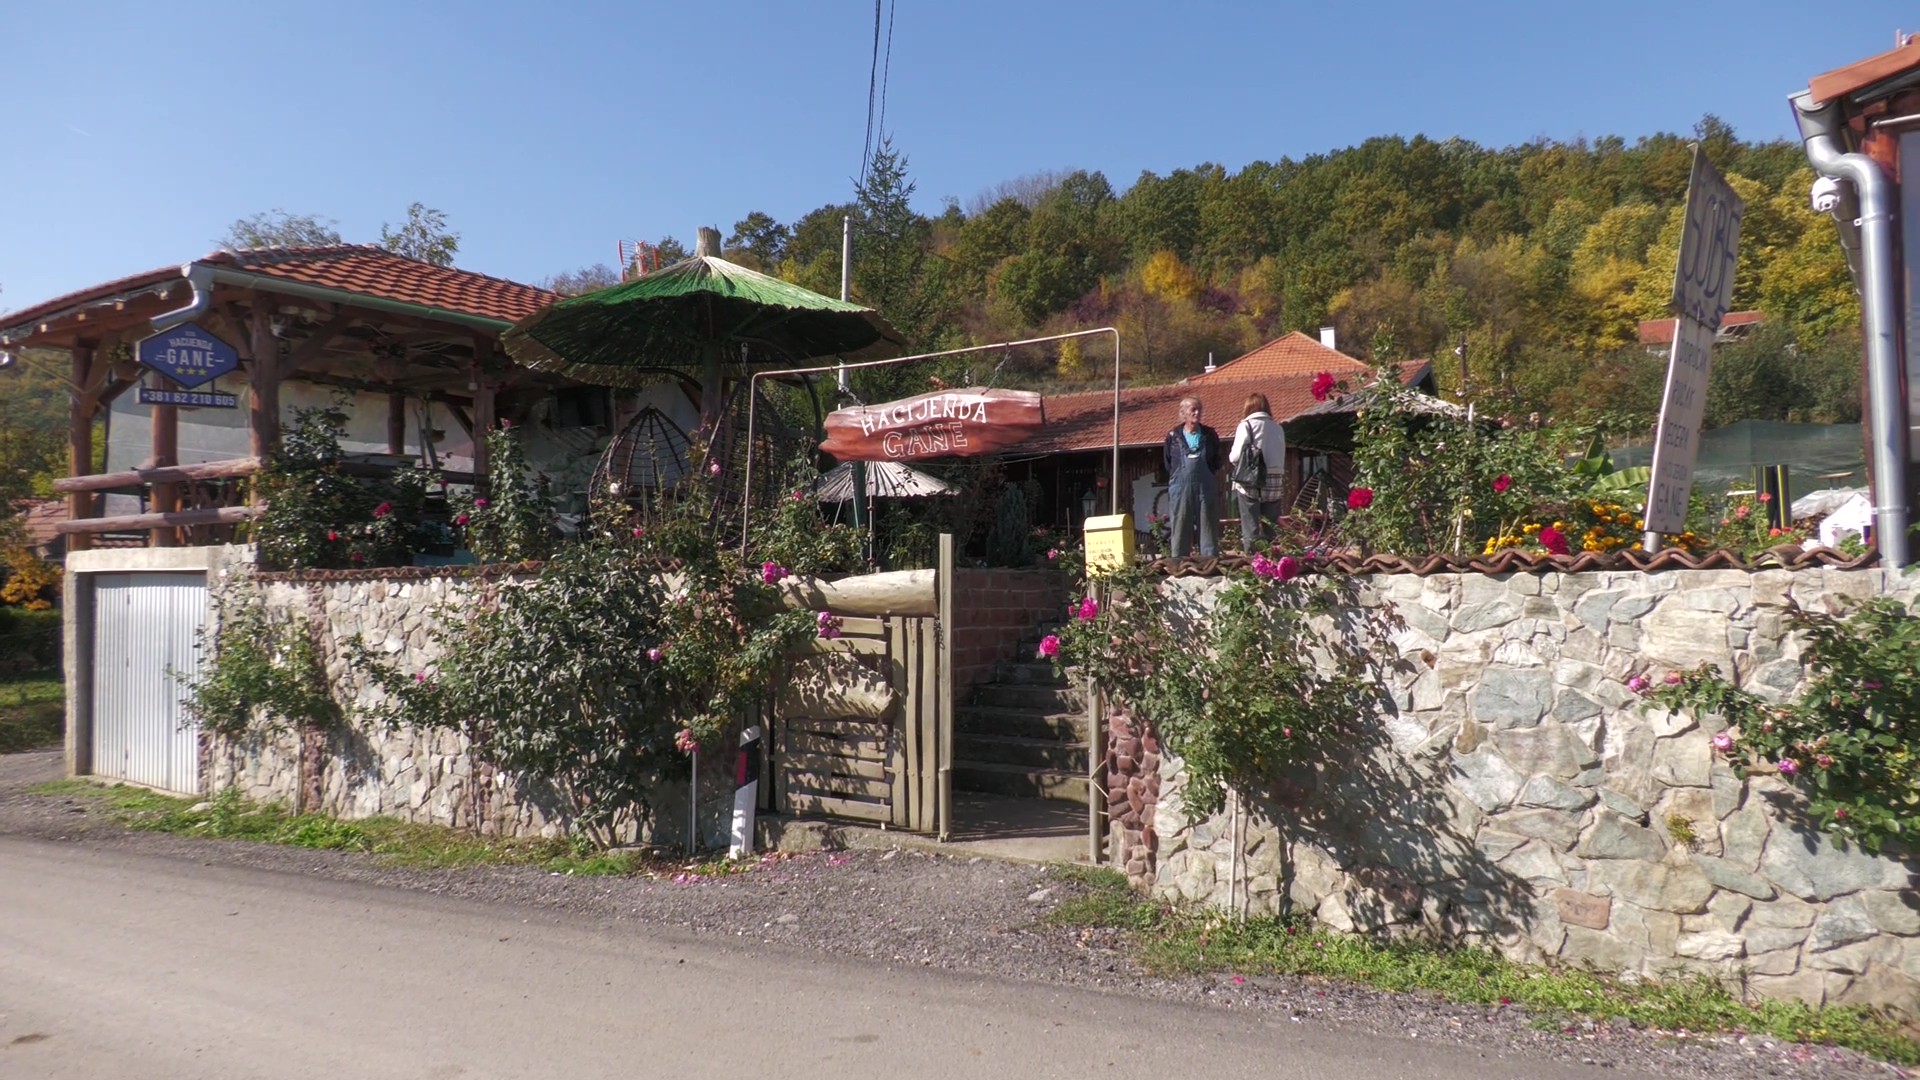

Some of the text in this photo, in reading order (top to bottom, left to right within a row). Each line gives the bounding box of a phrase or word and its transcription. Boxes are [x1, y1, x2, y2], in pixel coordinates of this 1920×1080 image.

[166, 348, 215, 367] GANE
[142, 391, 169, 402] +381
[174, 392, 188, 403] 62
[191, 394, 212, 405] 210
[860, 396, 987, 437] HACIJENDA
[882, 421, 968, 458] GANE
[1656, 482, 1684, 517] GANE
